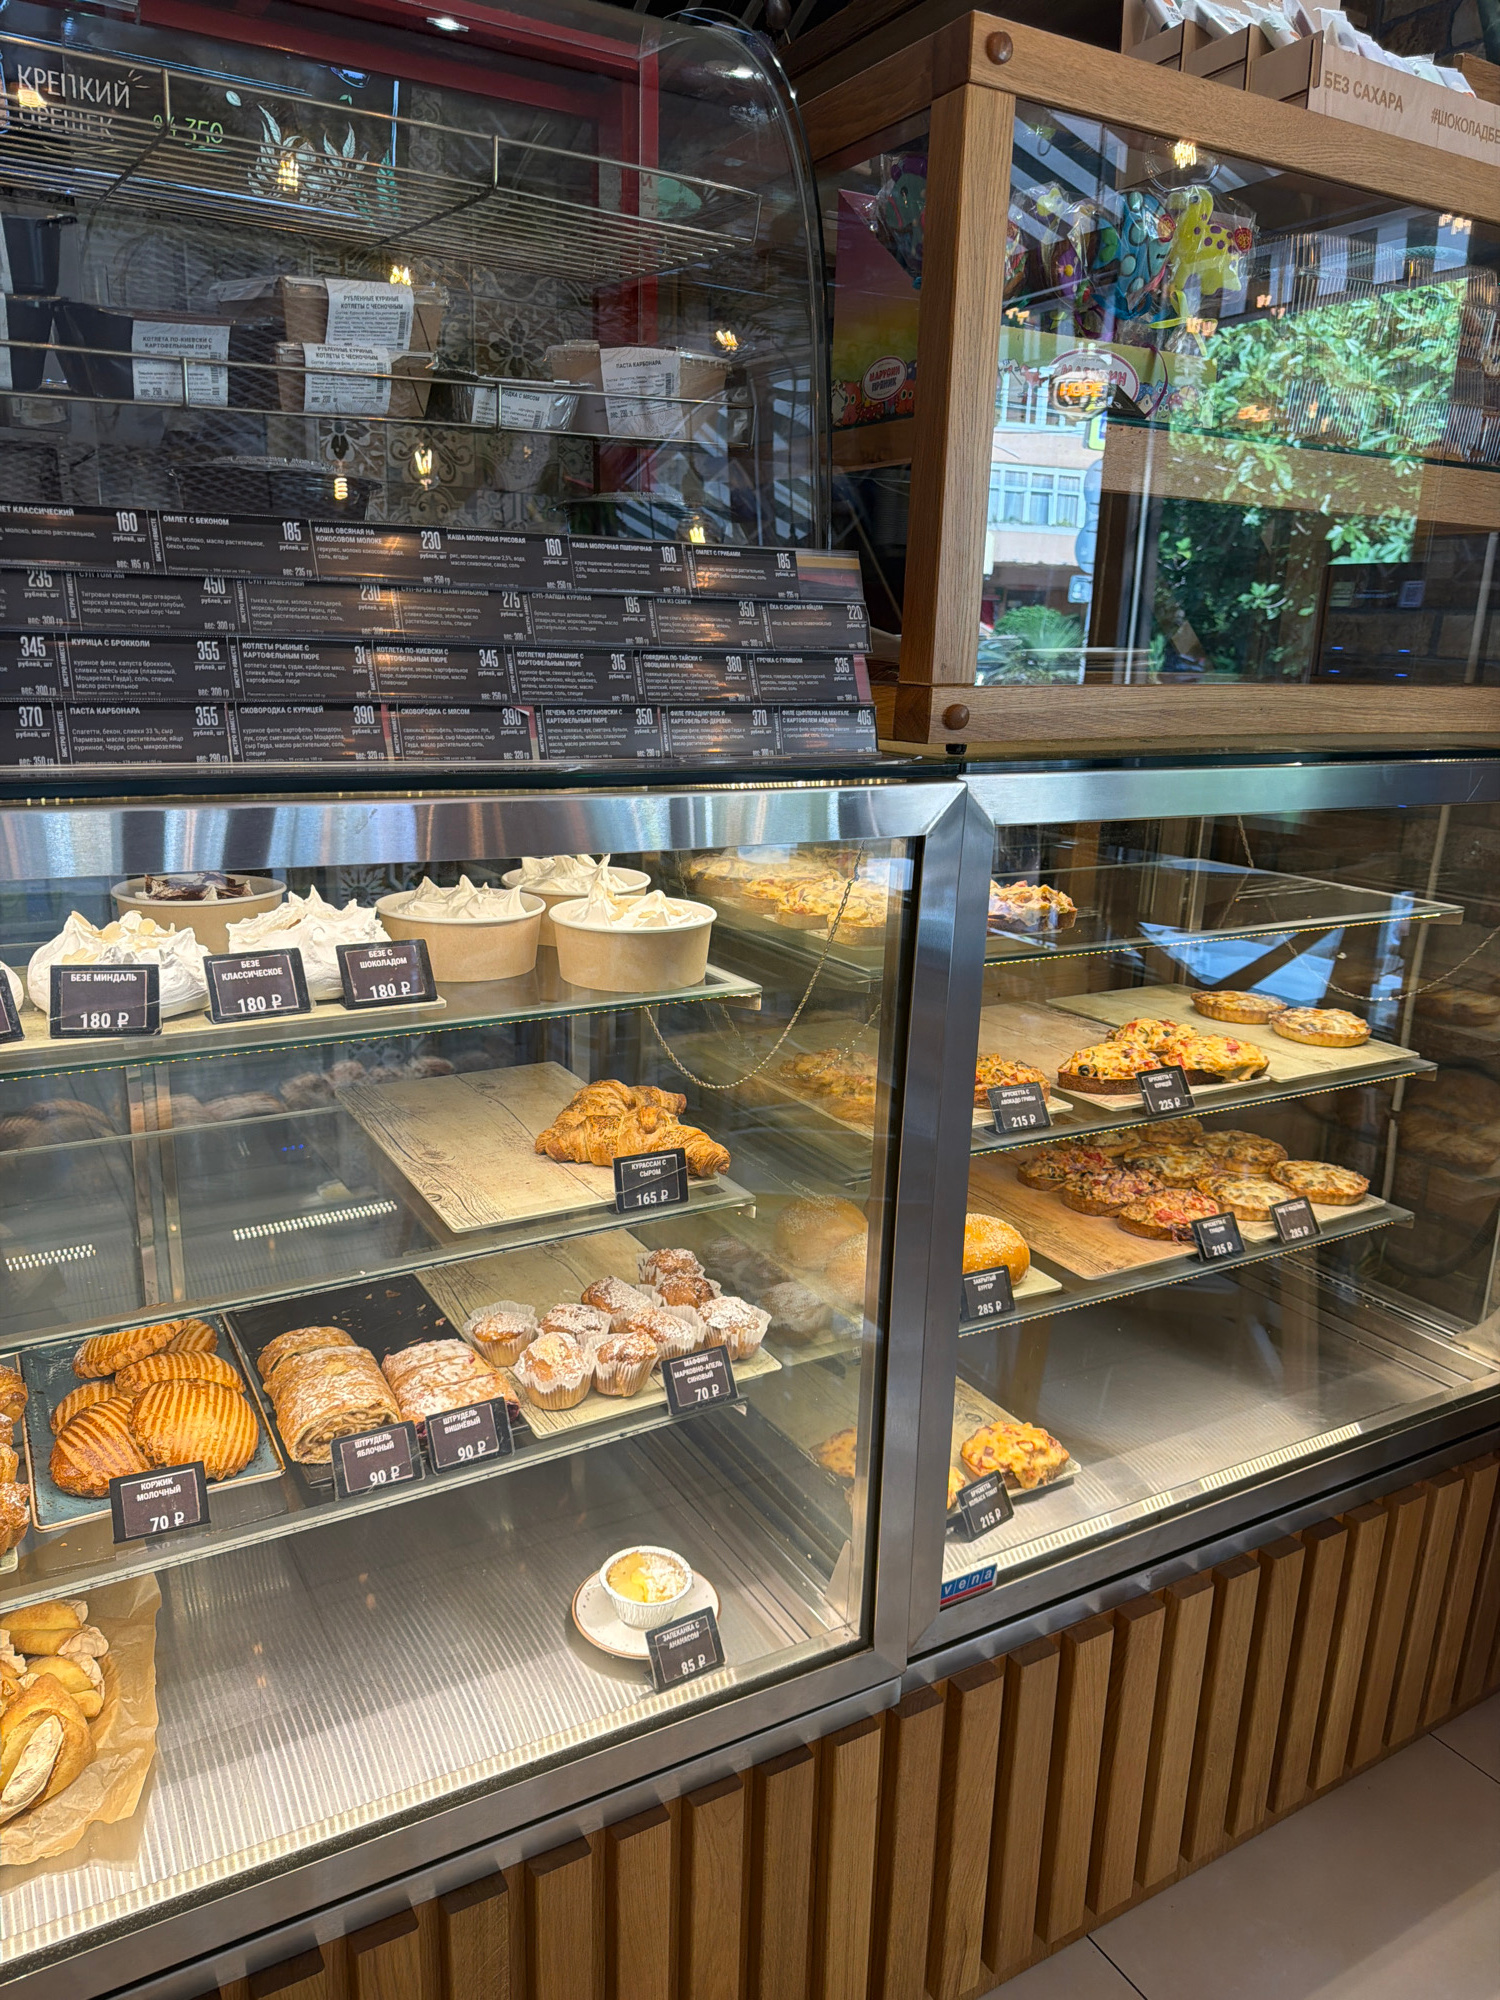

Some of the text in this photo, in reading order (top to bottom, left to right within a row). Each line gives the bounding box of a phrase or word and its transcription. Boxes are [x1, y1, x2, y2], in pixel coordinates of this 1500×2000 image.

[17, 64, 130, 109] КРЕПКИЙ
[1324, 70, 1404, 113] БЕЗ САХАРА
[144, 342, 194, 350] КАРТОФЕЛЬНЫМ
[633, 360, 662, 368] КАРБОНАРА
[13, 506, 74, 516] КЛАССИЧЕСКИЙ
[116, 511, 138, 532] 160
[163, 515, 187, 523] ОМЛЕТ
[196, 516, 229, 525] БЕКОНОМ
[282, 522, 301, 541] 185
[466, 535, 498, 543] МОЛОЧНАЯ
[421, 531, 441, 550] 230
[545, 539, 562, 556] 160
[777, 553, 791, 569] 185
[624, 597, 640, 613] 195
[739, 602, 755, 618] 350
[847, 605, 862, 620] 220
[20, 636, 46, 657] 345
[71, 638, 102, 647] КУРИЦА
[111, 639, 150, 647] БРОККОЛИ
[197, 641, 220, 660] 355
[242, 642, 274, 650] КОТЛЕТЫ
[275, 643, 303, 651] РЫБНЫЕ
[479, 650, 499, 668] 345
[517, 651, 546, 659] КОТЛЕТКИ
[611, 654, 626, 671] 315
[726, 656, 742, 672] 380
[835, 658, 850, 673] 335
[18, 706, 43, 728] 370
[97, 707, 140, 715] КАРБОНАРА
[195, 707, 218, 726] 355
[240, 707, 285, 715] СКОВОРОДКА
[293, 706, 323, 714] КУРИЦЕЙ
[353, 706, 374, 725] 390
[502, 708, 521, 726] 390
[636, 708, 653, 725] 350
[752, 710, 767, 726] 370
[857, 710, 871, 726] 405
[368, 950, 386, 958] БЕЗЕ
[241, 960, 260, 968] БЕЗЕ
[360, 957, 407, 969] ШОКОЛАДОМ
[71, 973, 137, 982] БЕЗЕ МИНДАЛЬ
[221, 967, 283, 981] КЛАССИЧЕСКОЕ
[369, 983, 396, 999] 180
[237, 996, 267, 1013] 180
[80, 1013, 111, 1028] 180
[1159, 1099, 1174, 1110] 225
[1011, 1115, 1028, 1127] 215
[632, 1161, 660, 1170] КУРАССАН
[639, 1168, 661, 1177] СЫРОМ
[636, 1191, 657, 1206] 165
[1212, 1243, 1227, 1256] 215
[978, 1303, 993, 1316] 285
[683, 1355, 708, 1367] МАФФИН
[674, 1361, 723, 1379] МАРКОВНО-АПЕЛЬ
[687, 1370, 713, 1384] СИНОВЫЙ
[694, 1387, 709, 1401] 70
[443, 1409, 478, 1425] ШТРУДЕЛЬ
[444, 1416, 481, 1434] ВИШНЕВЫЙ
[354, 1433, 391, 1449] ШТРУДЕЛЬ
[356, 1441, 395, 1458] ЯБЛОЧНЫЙ
[457, 1444, 474, 1461] 90
[141, 1477, 174, 1491] КОРЖИК
[369, 1470, 387, 1486] 90
[136, 1484, 181, 1502] МОЛОЧНЫЙ
[150, 1515, 169, 1532] 70
[980, 1512, 995, 1528] 215
[944, 1569, 992, 1595] vena
[662, 1623, 695, 1642] ЗАПЕКАНКА
[668, 1631, 699, 1649] АНАНАСОМ
[681, 1658, 695, 1675] 85
